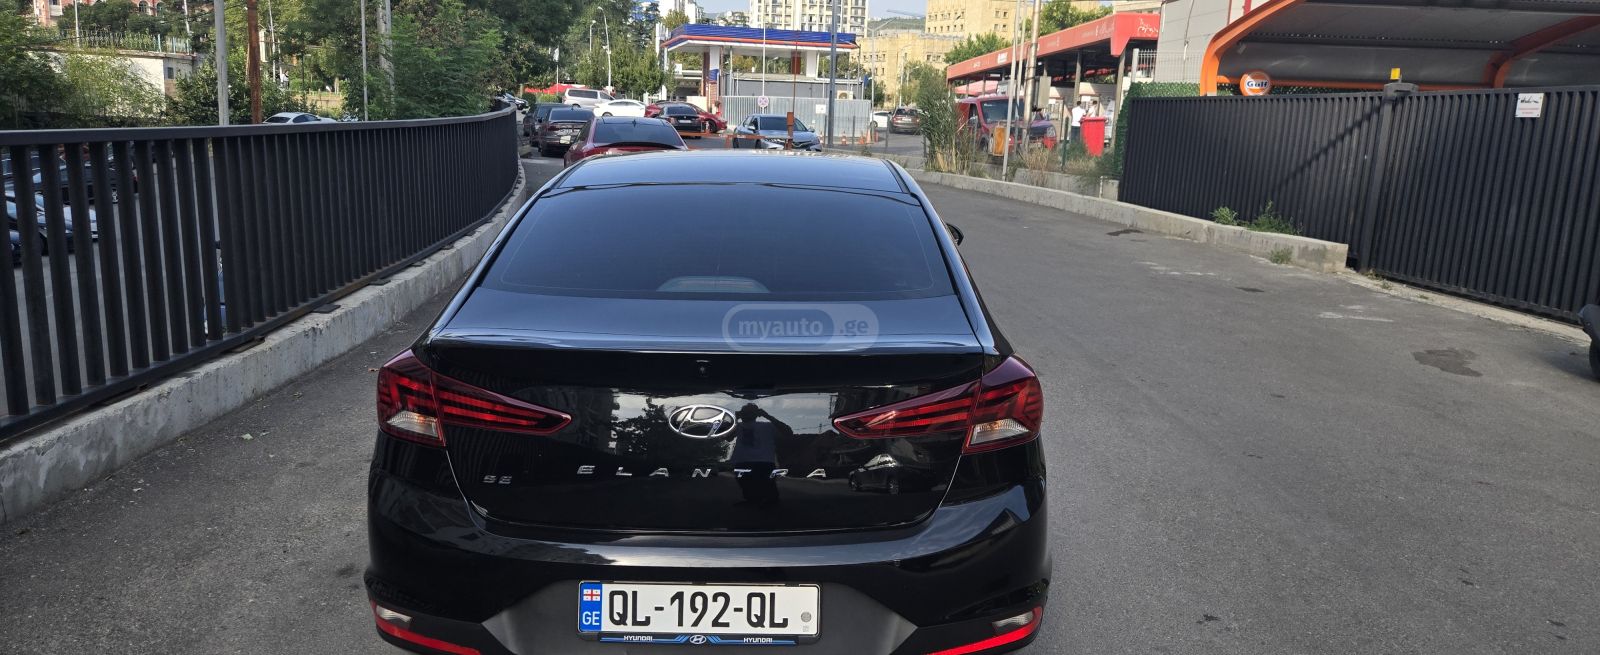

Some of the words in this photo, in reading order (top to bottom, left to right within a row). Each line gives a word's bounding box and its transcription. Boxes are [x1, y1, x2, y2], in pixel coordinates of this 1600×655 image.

[1246, 80, 1268, 88] Gulf
[576, 465, 827, 479] ELANTRA
[483, 475, 513, 485] SE
[608, 590, 789, 629] QL-192-QL
[582, 611, 600, 626] GE
